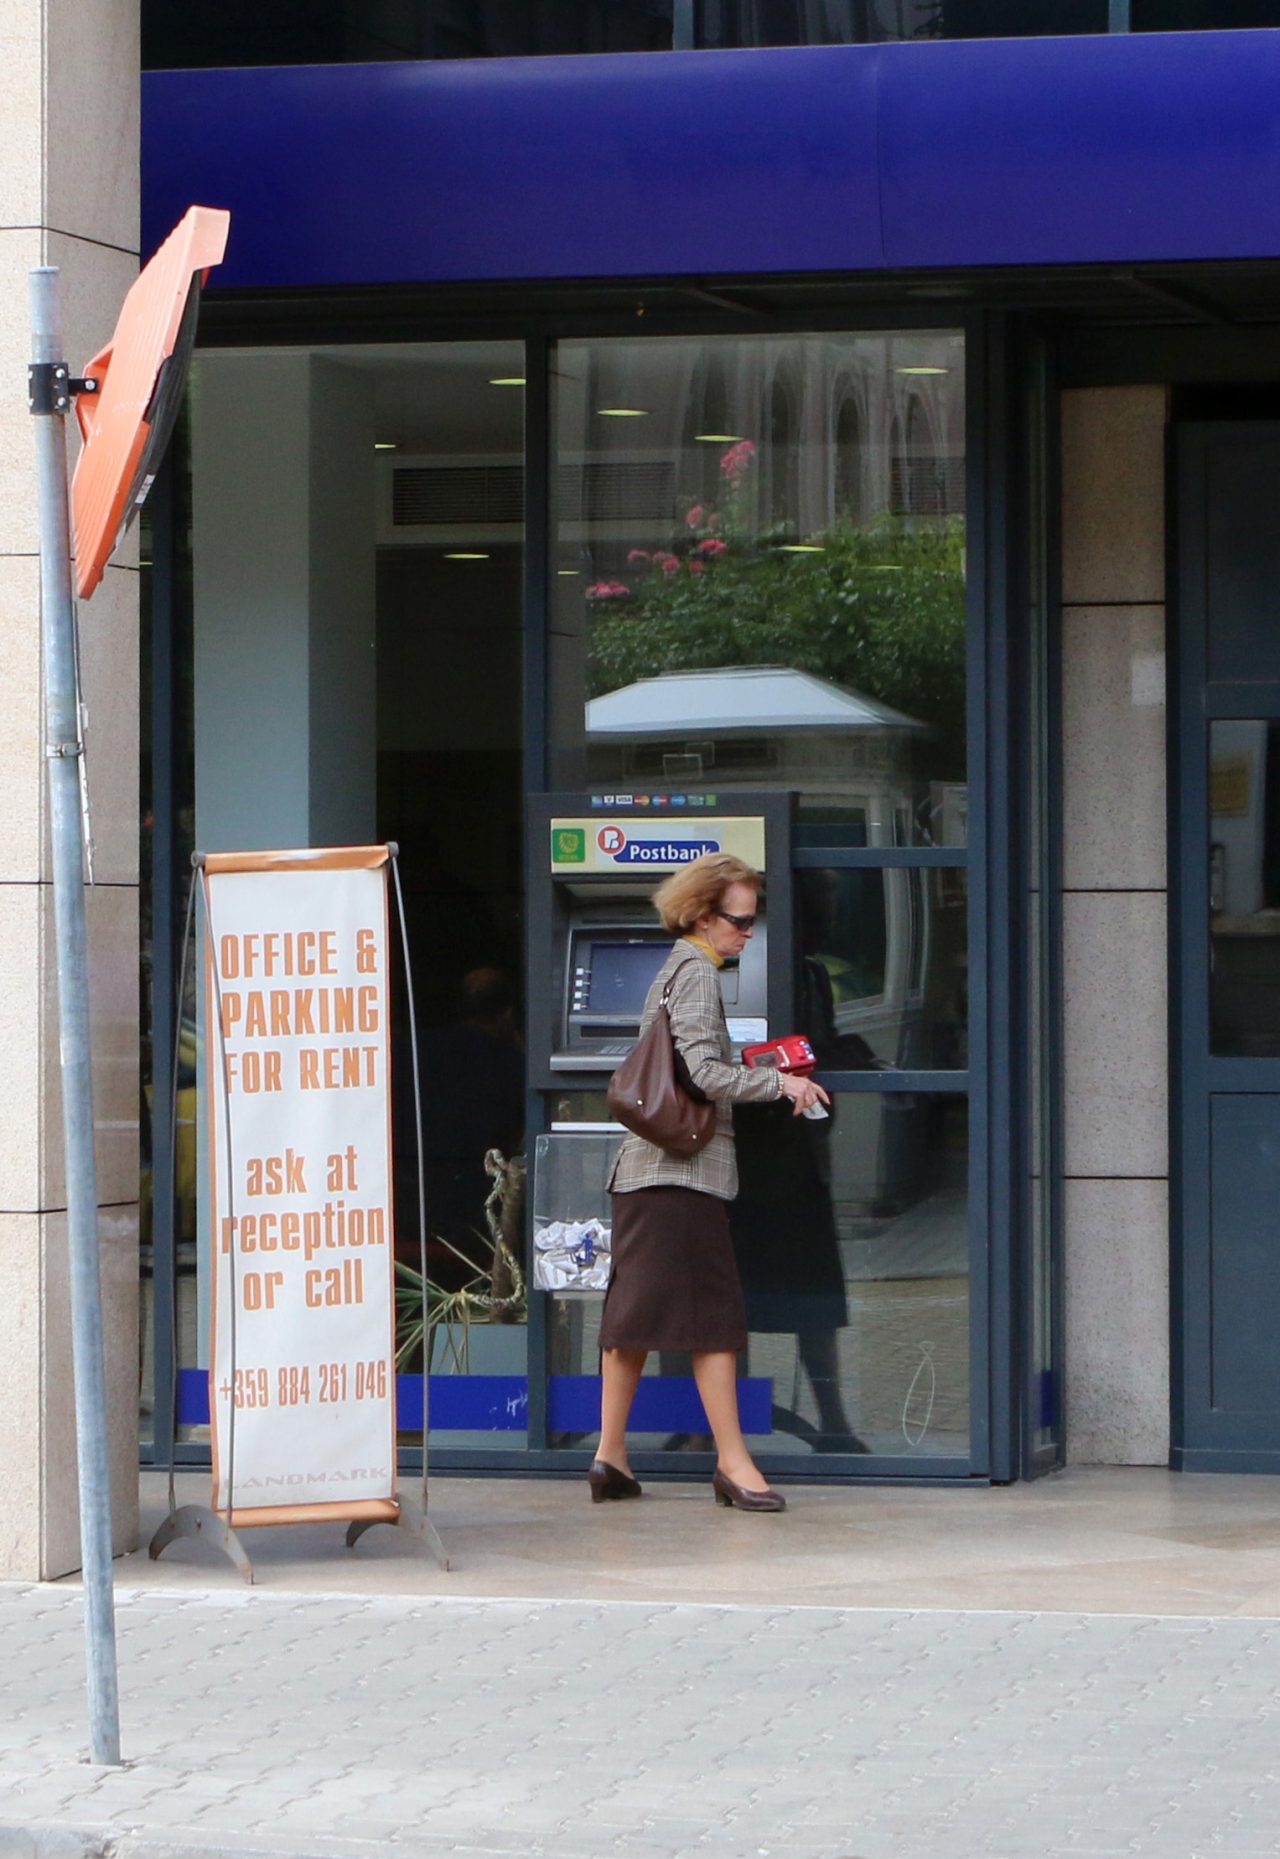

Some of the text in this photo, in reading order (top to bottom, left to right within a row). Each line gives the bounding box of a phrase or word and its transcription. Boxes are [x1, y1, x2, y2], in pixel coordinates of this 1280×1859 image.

[220, 928, 377, 979] OFFICE &
[222, 985, 378, 1038] PARKING
[226, 1046, 378, 1094] FOR RENT
[246, 1145, 358, 1196] ask at
[222, 1200, 384, 1260] reception
[243, 1258, 363, 1311] or call
[219, 1359, 386, 1408] +359 884 261 046
